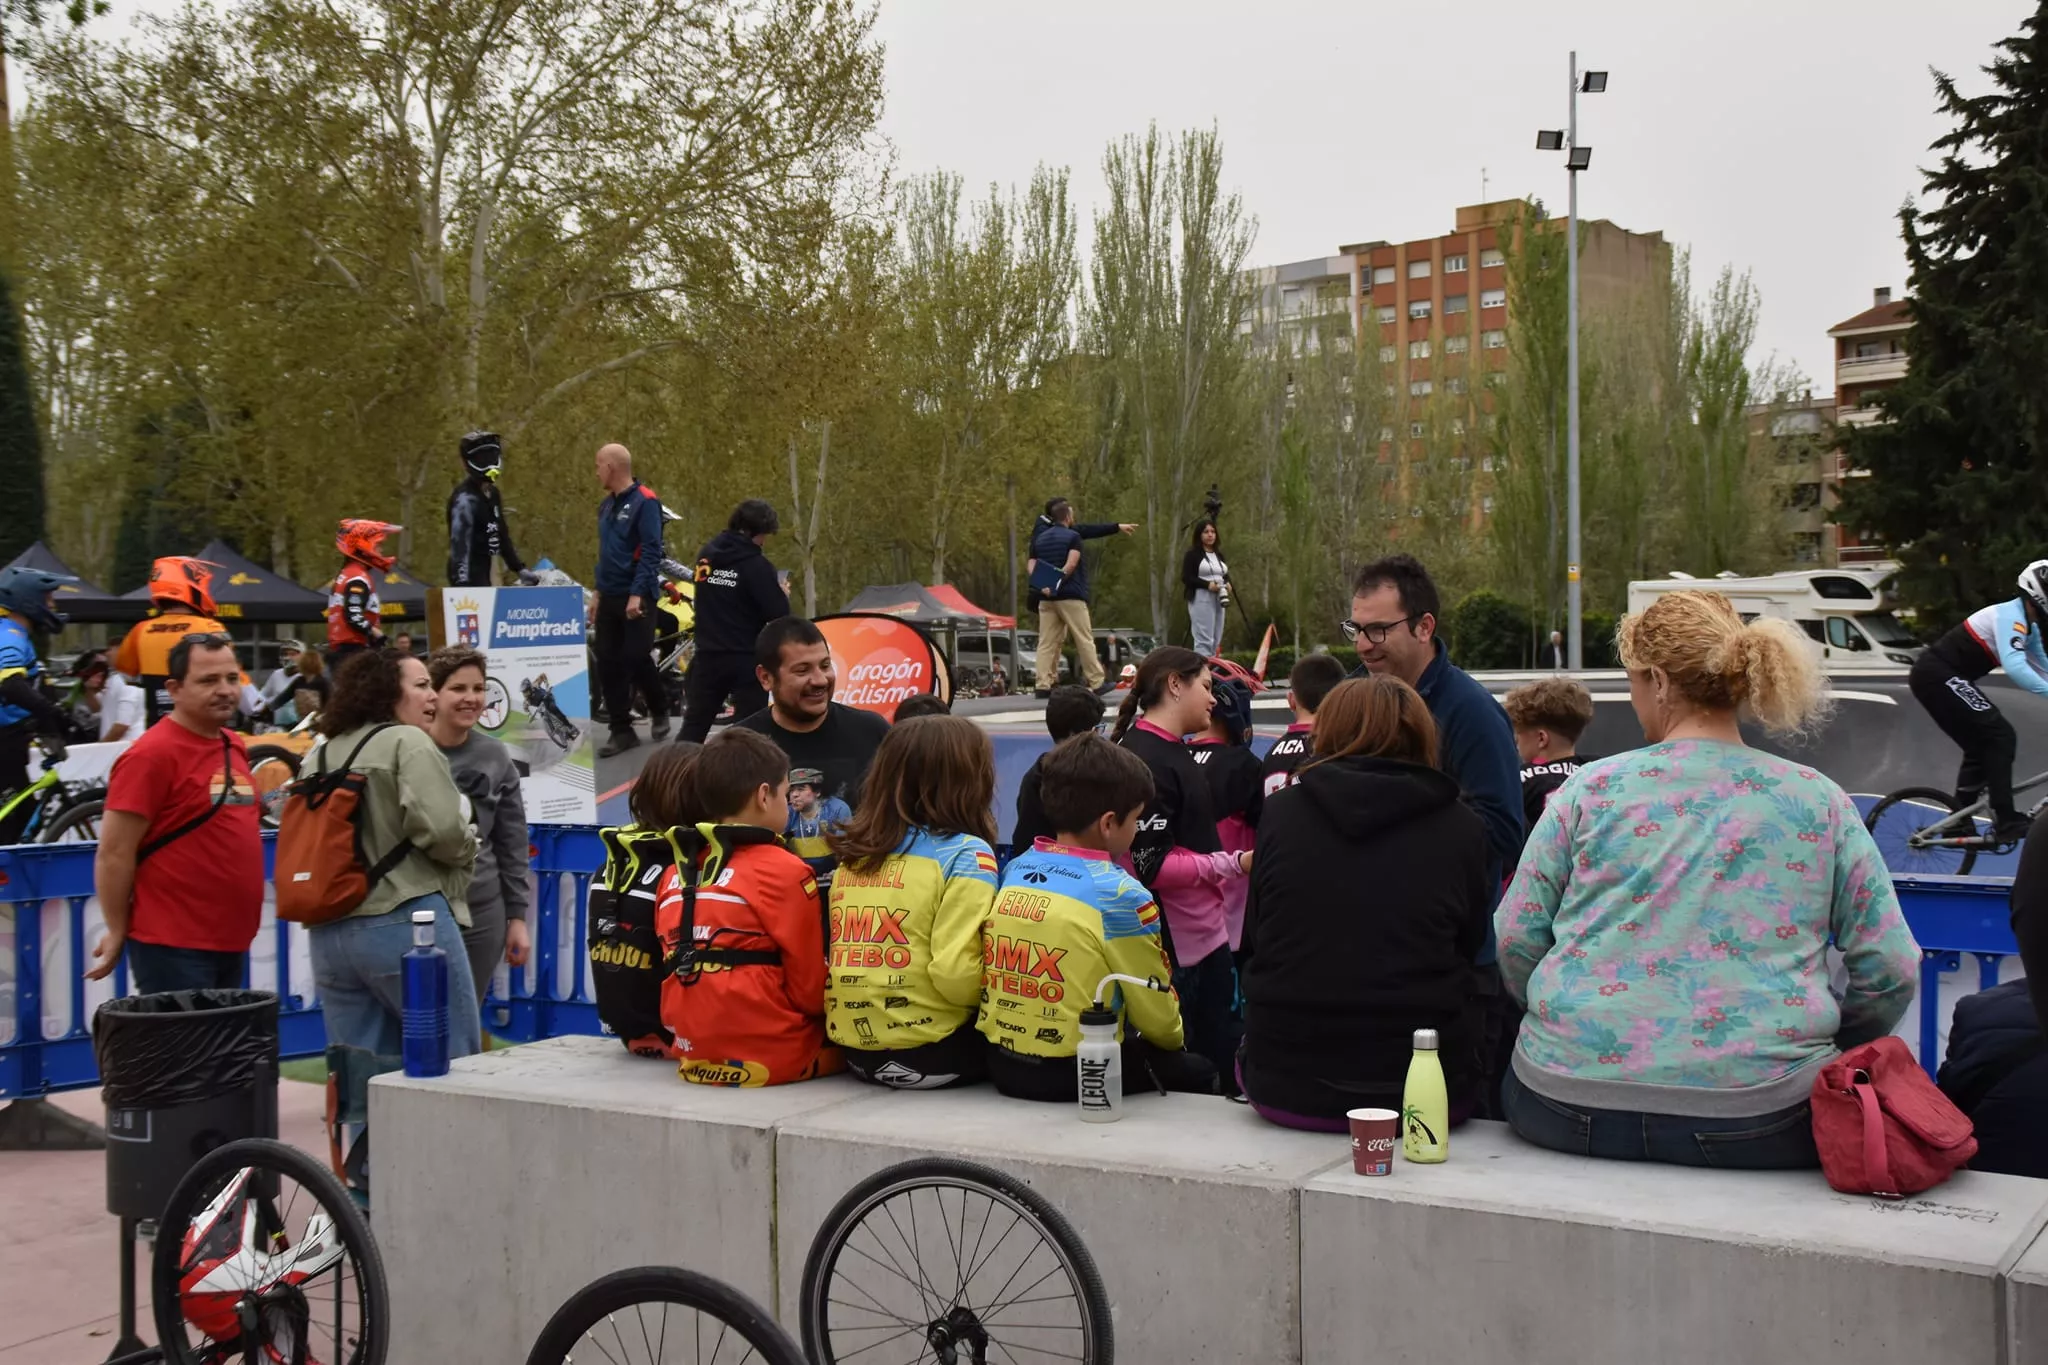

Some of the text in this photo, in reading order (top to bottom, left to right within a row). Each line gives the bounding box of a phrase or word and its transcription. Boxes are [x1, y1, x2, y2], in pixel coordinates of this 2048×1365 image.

[707, 576, 737, 587] ciclismo
[507, 607, 548, 620] MONZÓN
[496, 618, 581, 641] Pumptrack
[849, 657, 922, 684] aragón
[998, 890, 1051, 922] ERIC
[831, 906, 910, 945] BMX
[983, 933, 1068, 983] BMX
[995, 1018, 1027, 1034] RECARO
[1081, 1058, 1112, 1107] LEONE
